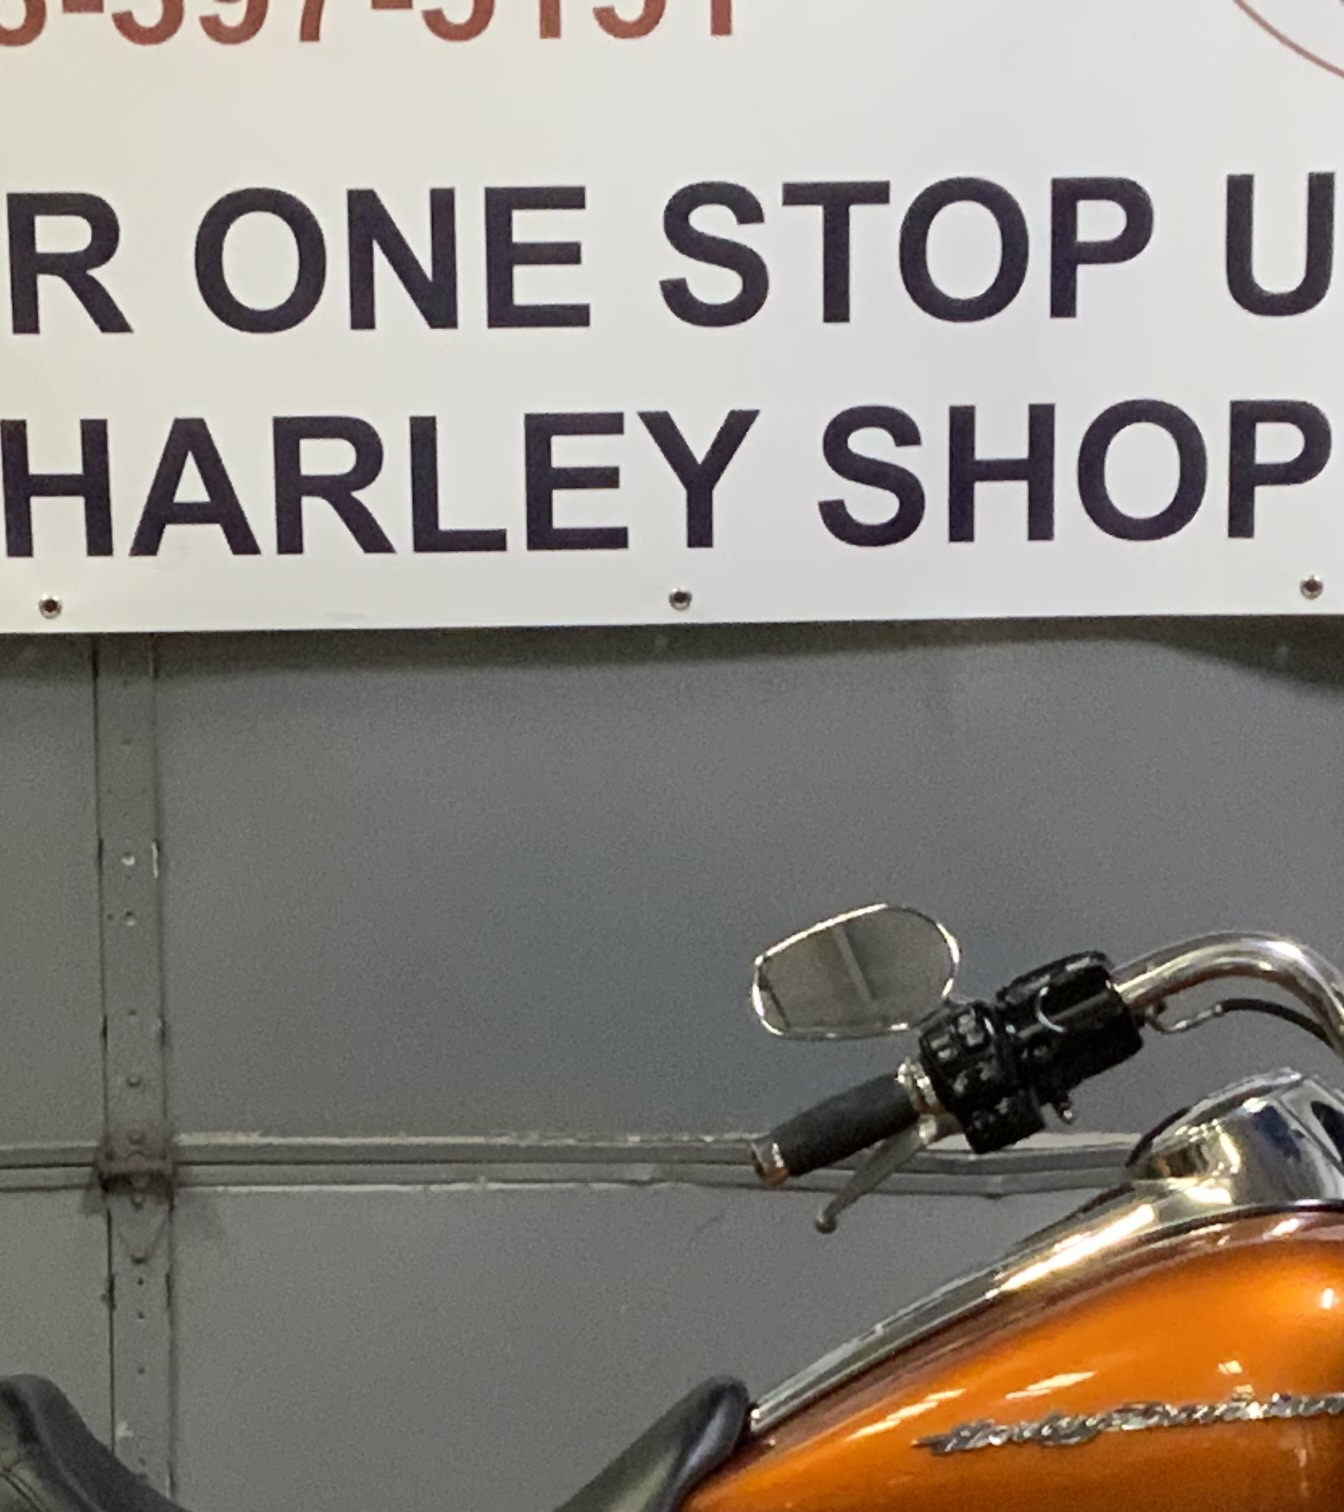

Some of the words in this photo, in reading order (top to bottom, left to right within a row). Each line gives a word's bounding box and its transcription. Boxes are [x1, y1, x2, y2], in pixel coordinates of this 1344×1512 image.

[194, 186, 591, 334] ONE
[659, 177, 1154, 328] STOP
[0, 409, 760, 558] HARLEY
[818, 399, 1332, 548] SHOP
